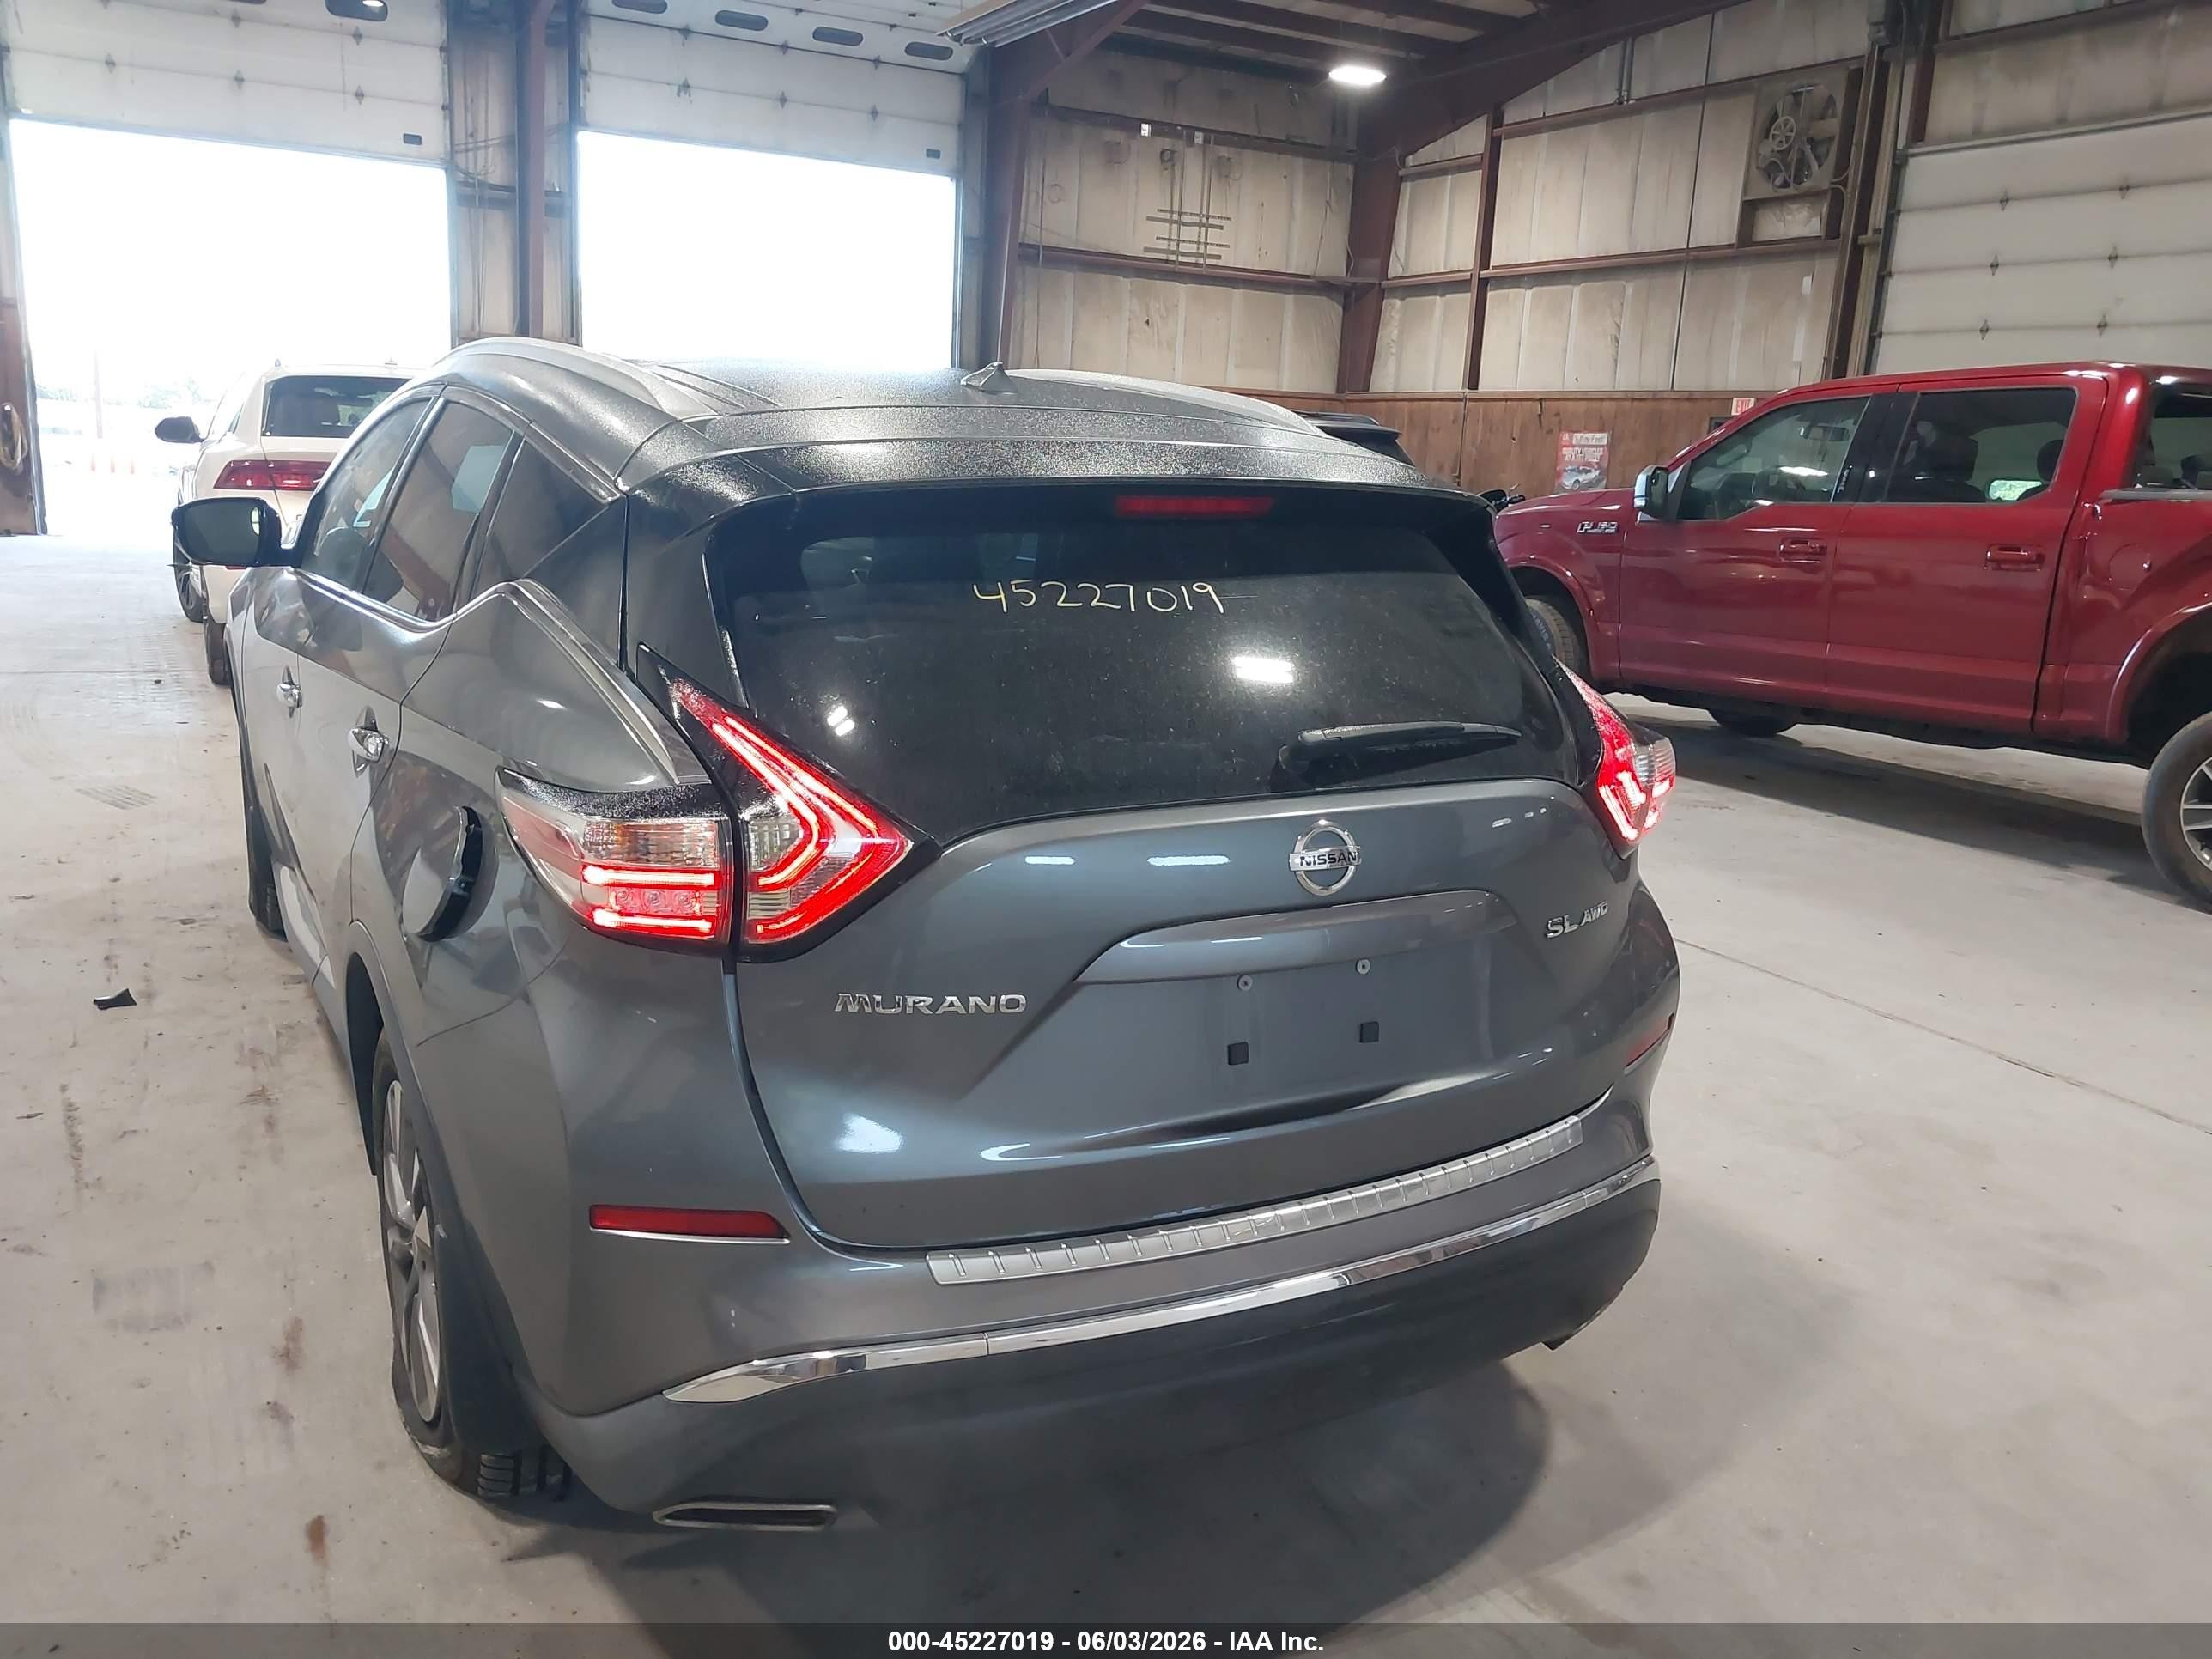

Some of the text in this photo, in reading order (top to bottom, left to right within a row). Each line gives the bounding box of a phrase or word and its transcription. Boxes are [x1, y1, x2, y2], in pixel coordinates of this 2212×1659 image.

[973, 579, 1224, 613] 45227019
[1298, 851, 1357, 867] NISSAN
[1546, 900, 1608, 939] SL AWD
[834, 993, 1027, 1015] MURANO
